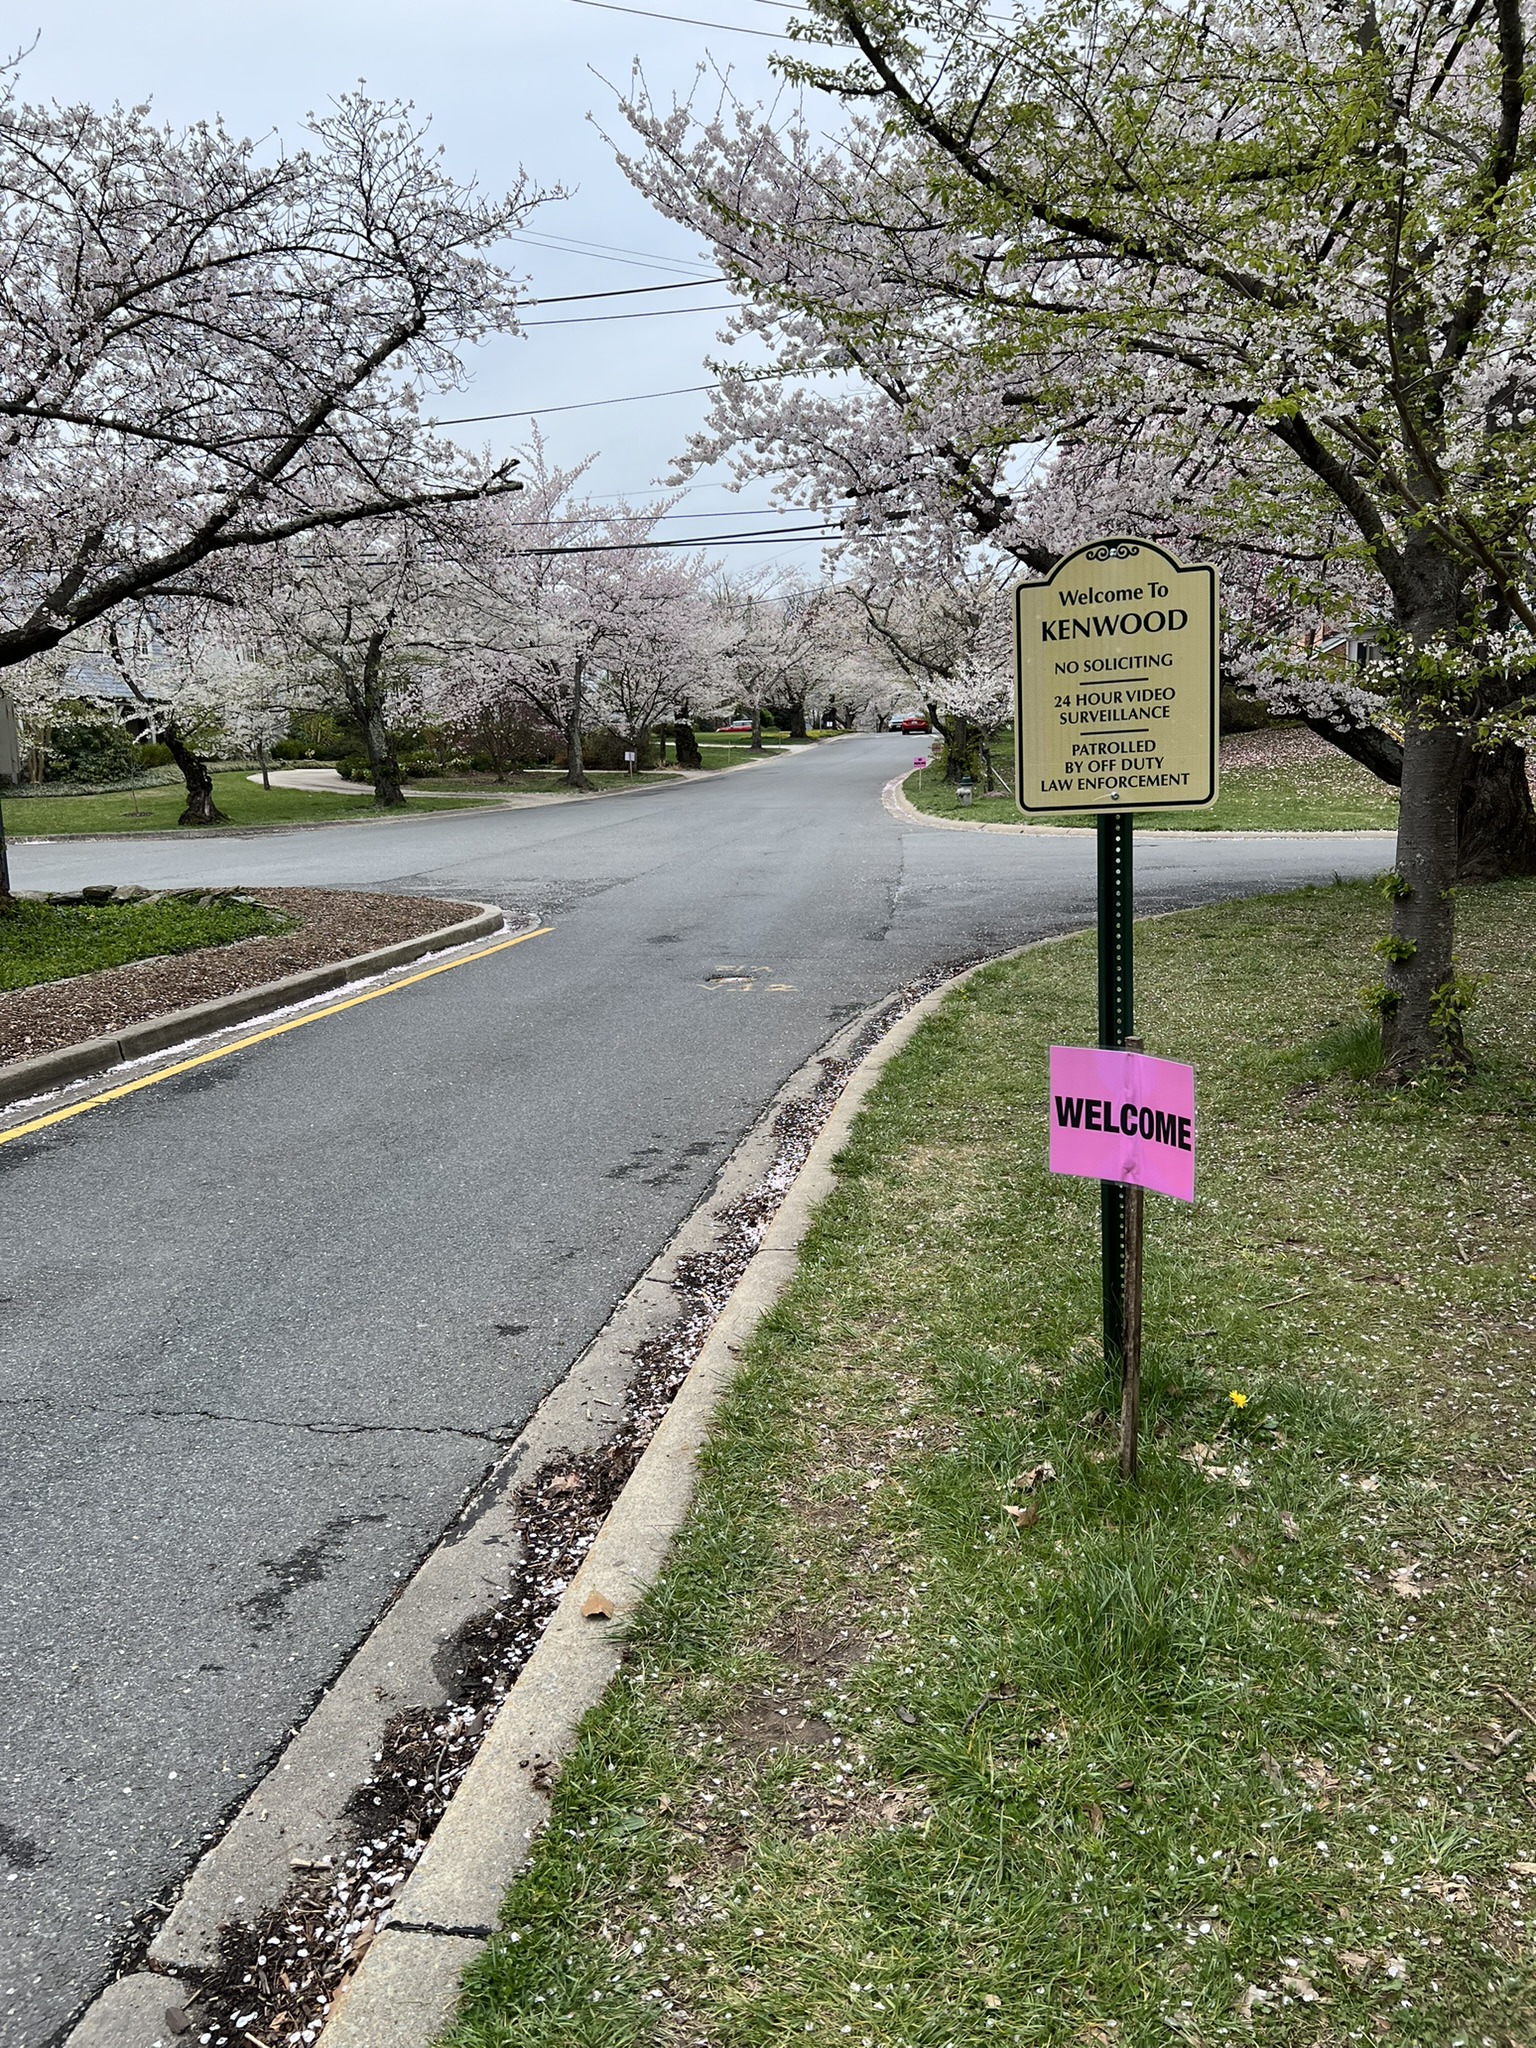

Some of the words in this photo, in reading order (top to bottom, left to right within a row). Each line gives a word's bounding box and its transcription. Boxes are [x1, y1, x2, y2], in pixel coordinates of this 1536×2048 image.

[1059, 587, 1143, 606] Welcome
[1148, 582, 1168, 598] To
[1042, 609, 1188, 642] KENWOOD
[1055, 661, 1079, 674] NO
[1084, 654, 1173, 672] SOLICITING
[1054, 695, 1071, 707] 24
[1076, 691, 1123, 706] HOUR
[1126, 688, 1176, 702] VIDEO
[1060, 706, 1170, 724] SURVEILLANCE
[1072, 740, 1156, 756] PATROLLED
[1065, 761, 1083, 773] BY
[1088, 760, 1116, 772] OFF
[1121, 757, 1164, 771] DUTY
[1041, 779, 1073, 792] LAW
[1077, 773, 1190, 790] ENFORCEMENT
[1055, 1096, 1191, 1152] WELCOME
